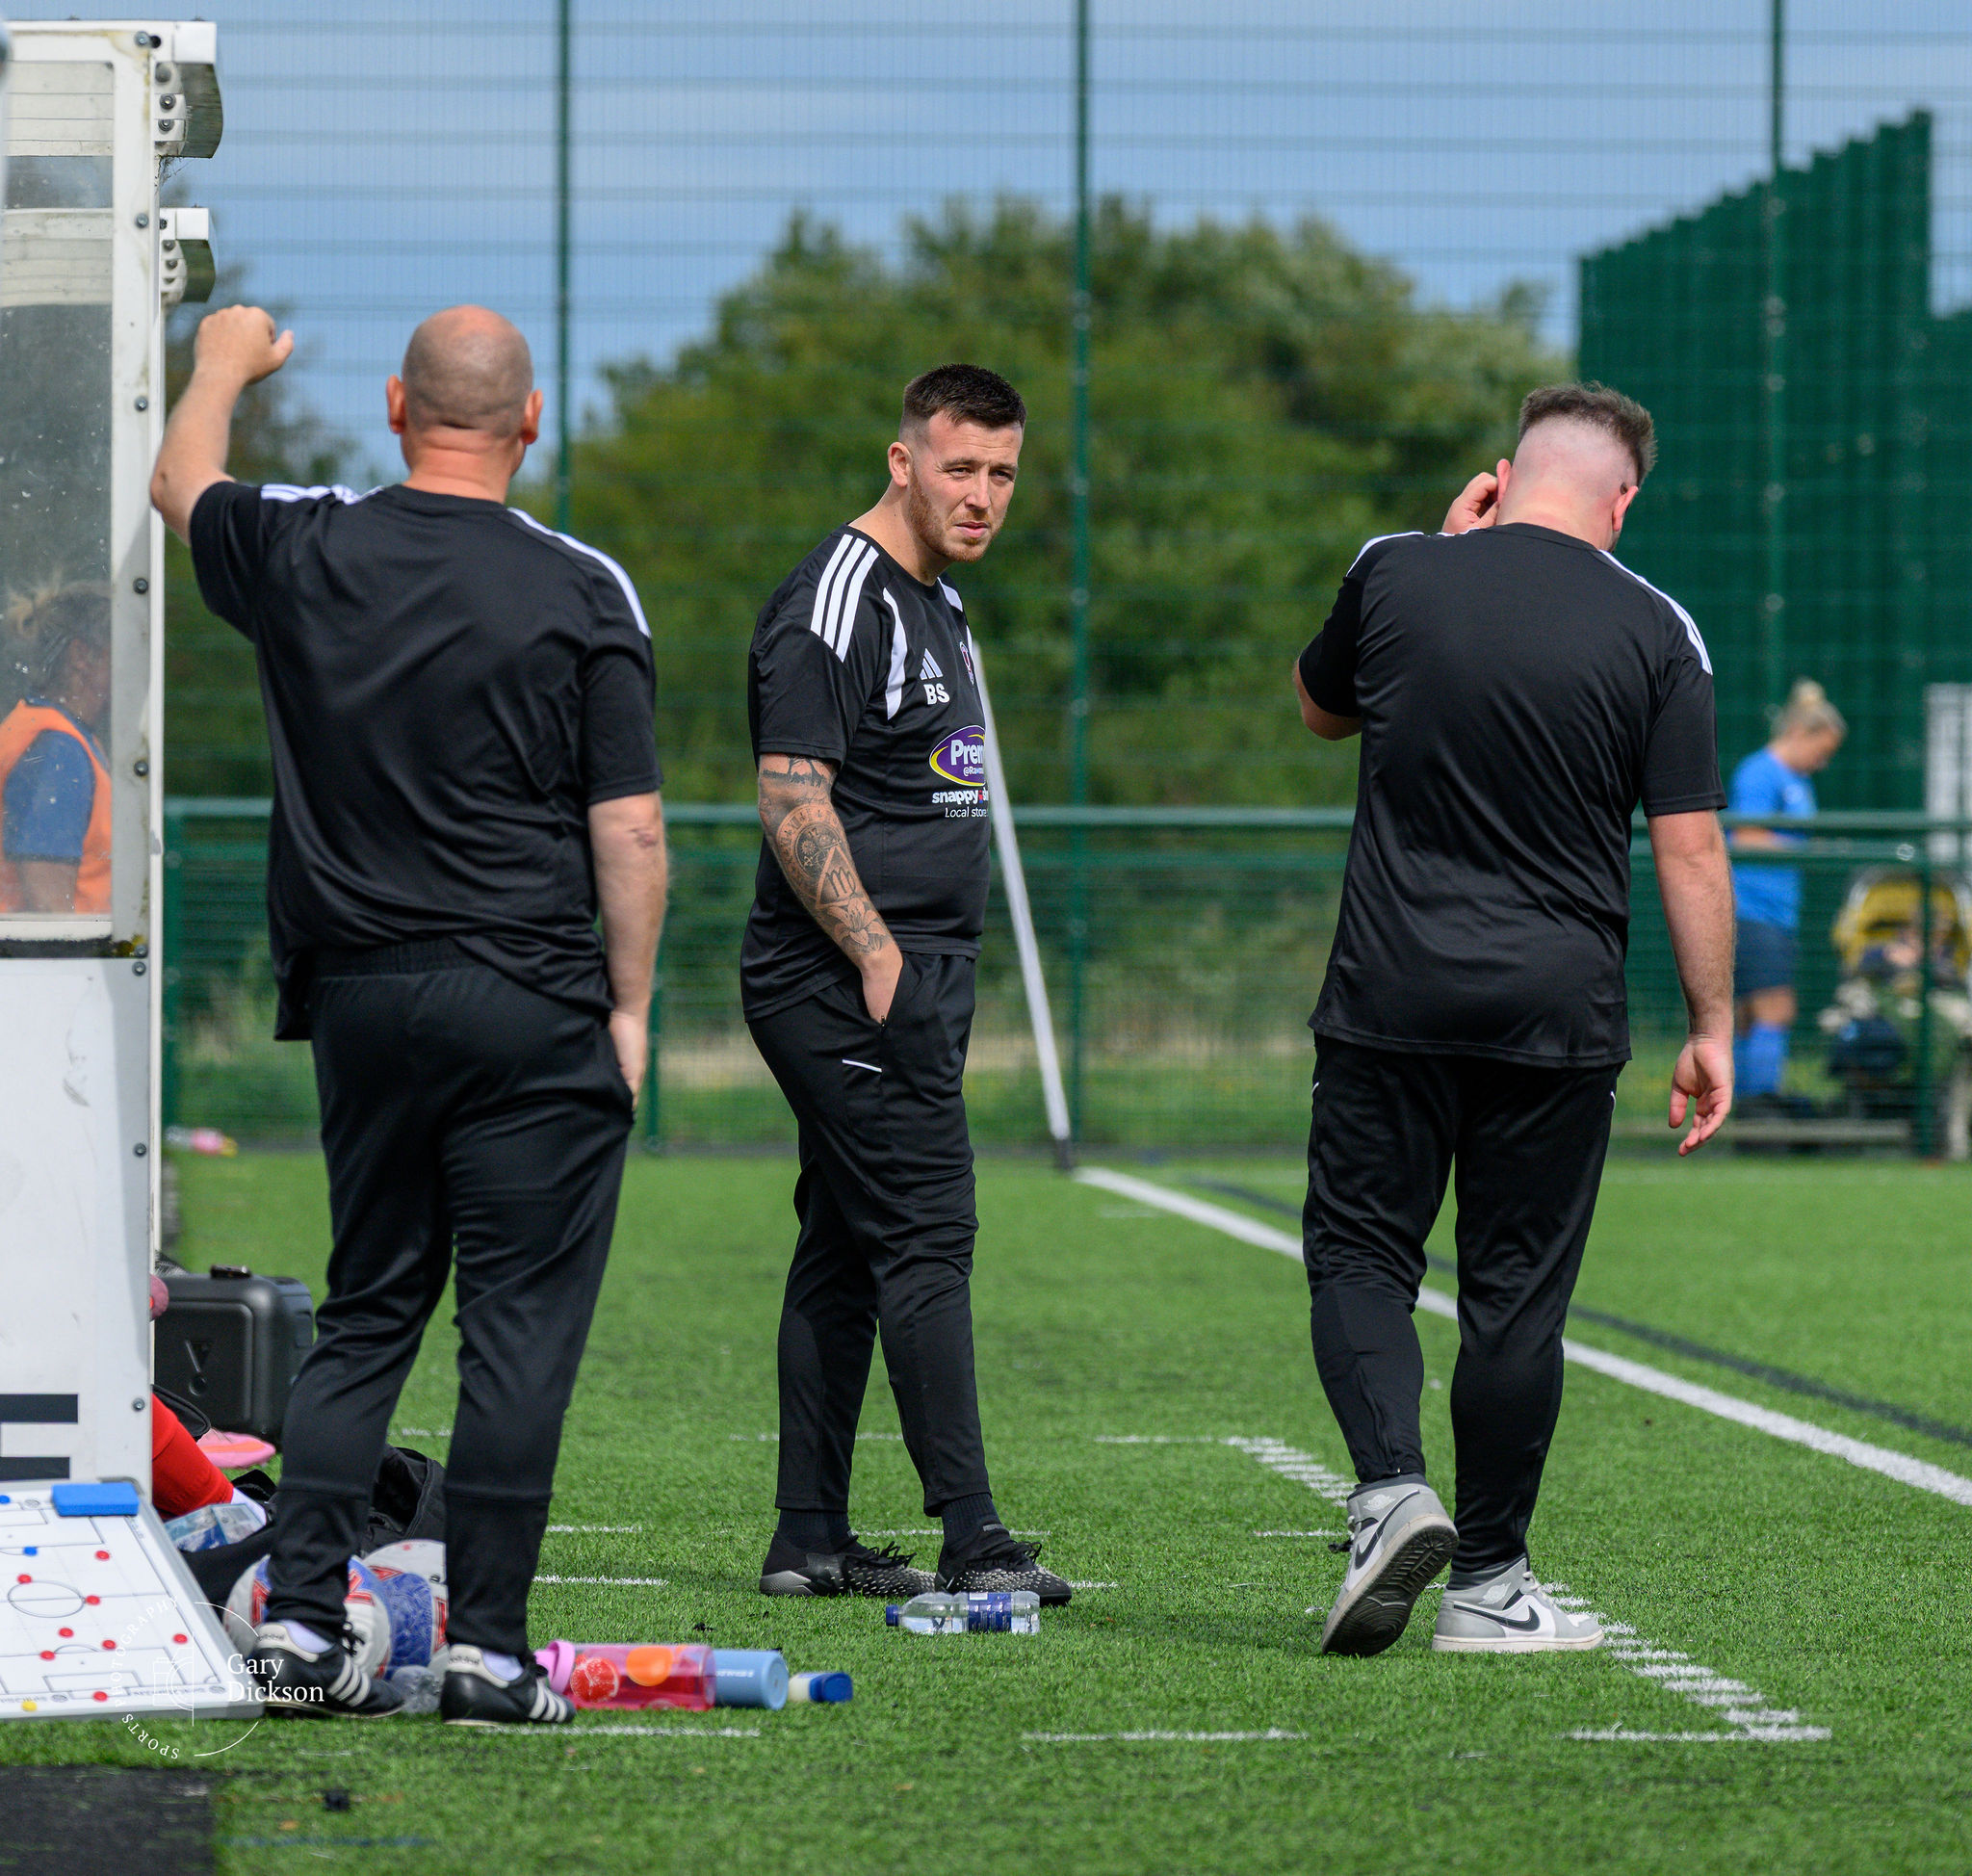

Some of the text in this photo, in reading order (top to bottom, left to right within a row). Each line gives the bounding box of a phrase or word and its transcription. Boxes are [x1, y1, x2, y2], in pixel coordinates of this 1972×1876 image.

[924, 684, 950, 705] BS
[931, 789, 979, 805] snappy
[945, 806, 970, 818] Local
